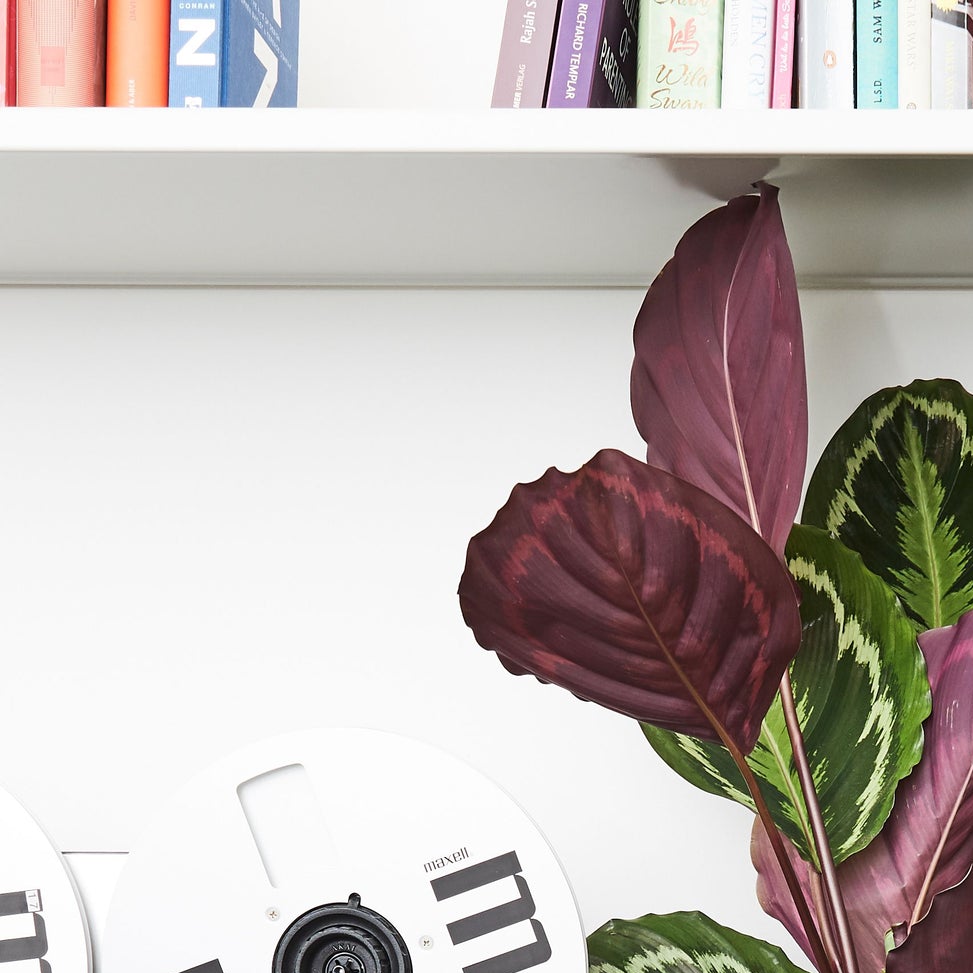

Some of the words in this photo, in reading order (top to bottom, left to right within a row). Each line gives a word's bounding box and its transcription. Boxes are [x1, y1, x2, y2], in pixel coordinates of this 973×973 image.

[520, 12, 537, 44] Rajah
[573, 4, 588, 51] RICHARD
[873, 15, 882, 44] SAM
[516, 64, 526, 91] VERLAG
[565, 52, 582, 100] TEMPLAR
[874, 78, 882, 103] L.S.D.
[423, 846, 470, 874] maxell
